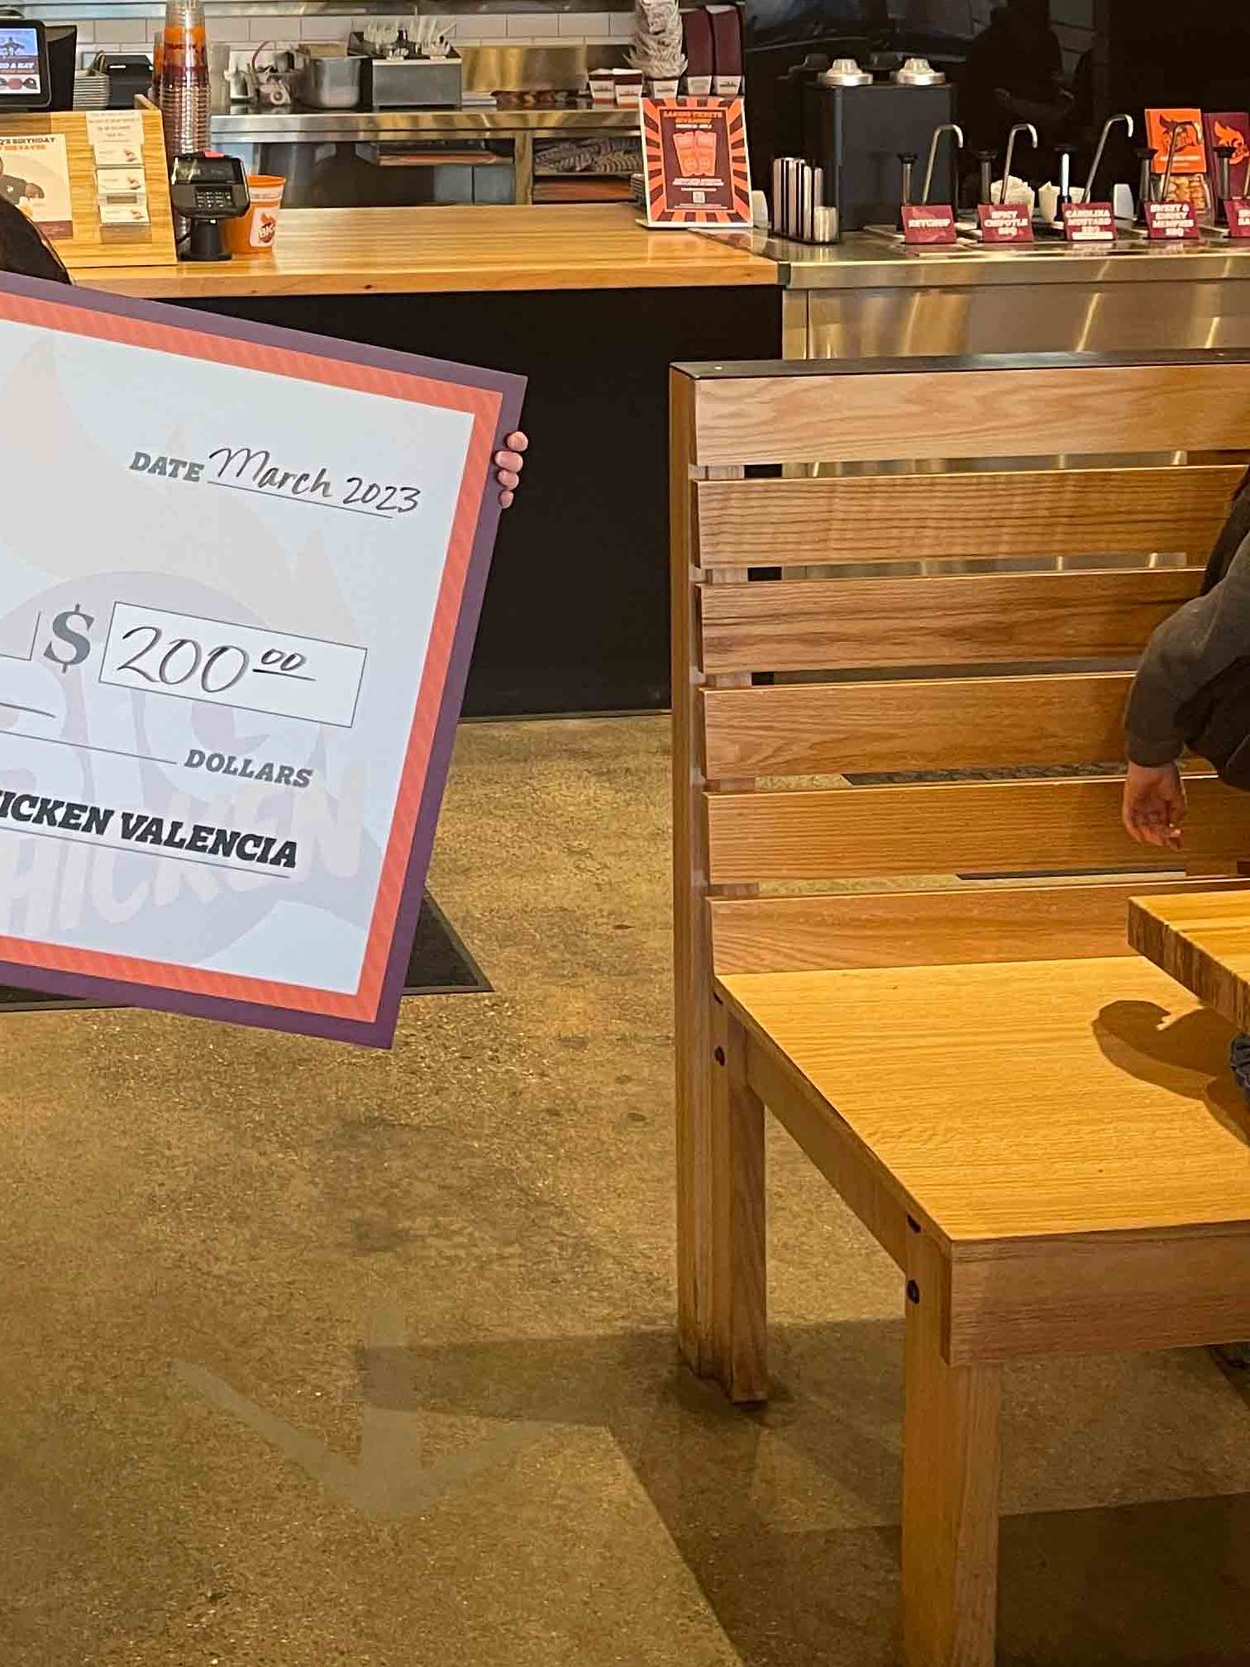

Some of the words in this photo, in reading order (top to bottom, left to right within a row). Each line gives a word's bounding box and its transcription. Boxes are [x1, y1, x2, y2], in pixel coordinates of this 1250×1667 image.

[129, 451, 205, 483] DATE
[208, 446, 332, 498] March
[342, 476, 421, 514] 2023
[43, 602, 95, 673] $
[184, 748, 313, 790] DOLLARS
[119, 811, 298, 870] VALENCIA
